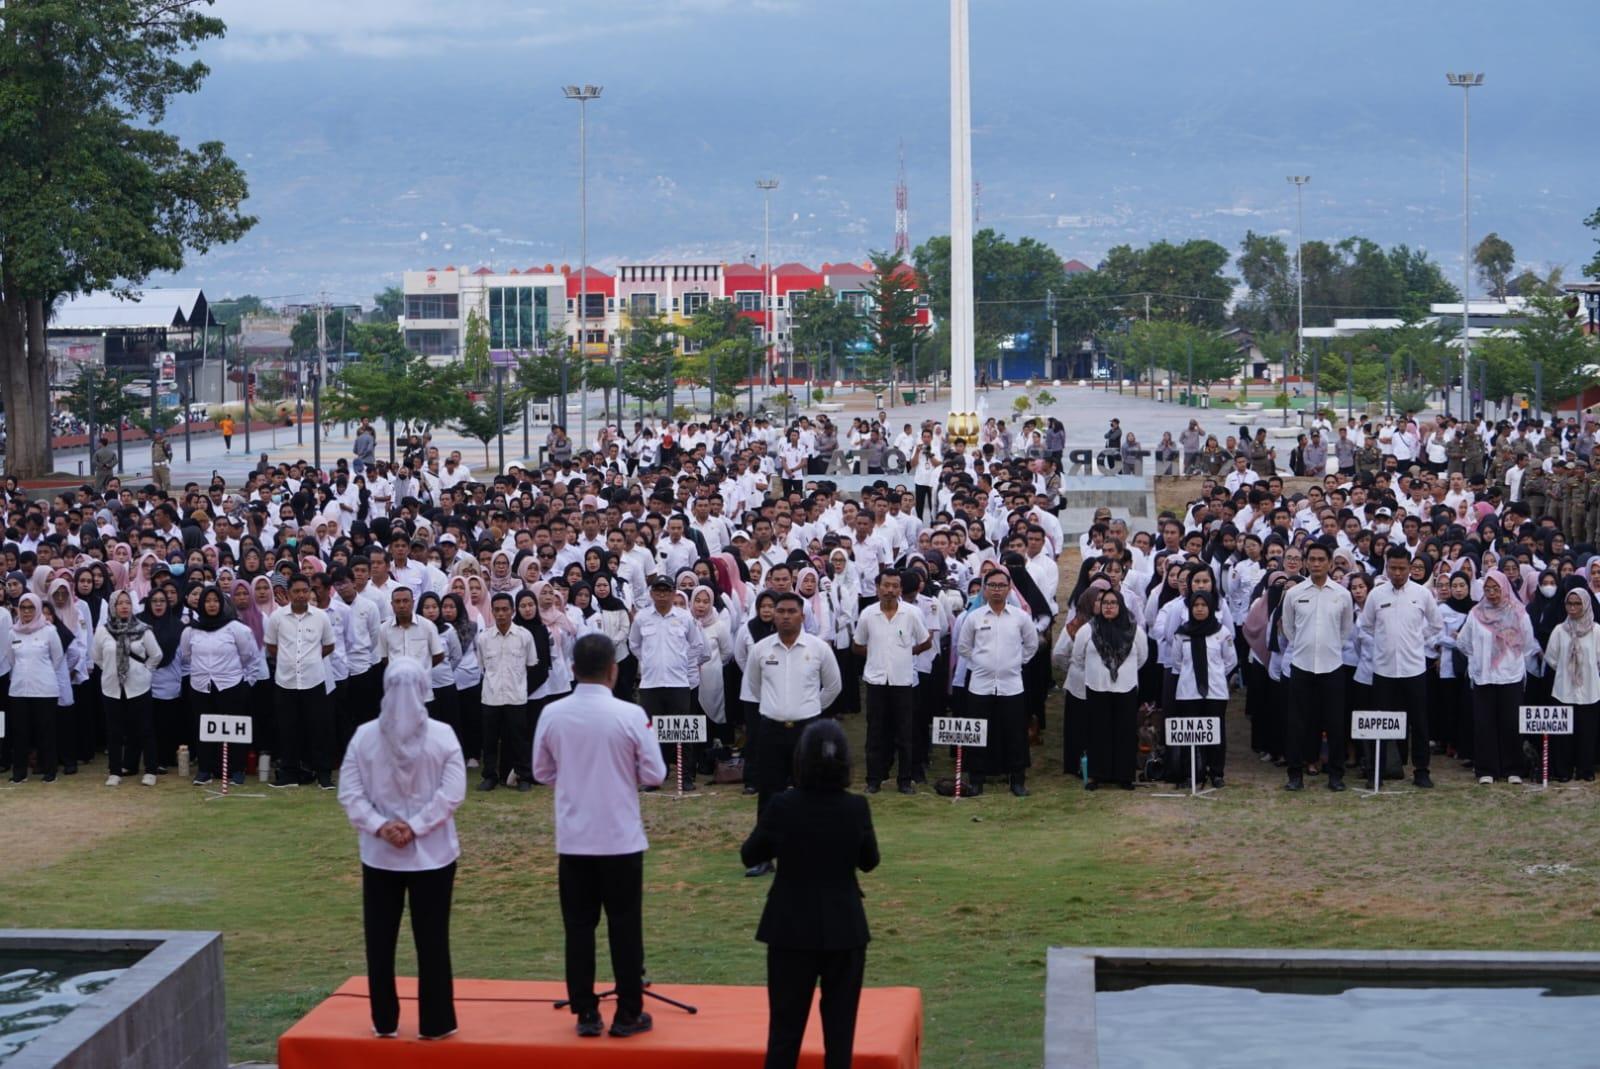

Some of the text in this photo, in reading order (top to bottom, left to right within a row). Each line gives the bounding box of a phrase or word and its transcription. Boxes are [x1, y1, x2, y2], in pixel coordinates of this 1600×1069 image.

[1525, 707, 1568, 720] BADAN
[207, 720, 246, 736] DLH
[657, 718, 699, 730] DINAS
[939, 719, 981, 733] DINAS
[1170, 718, 1213, 731] DINAS
[1358, 717, 1400, 730] BAPPEDA
[1525, 720, 1568, 732] KEUANGAN
[657, 730, 700, 741] PARIWISATA
[1170, 731, 1213, 743] KOMINFO
